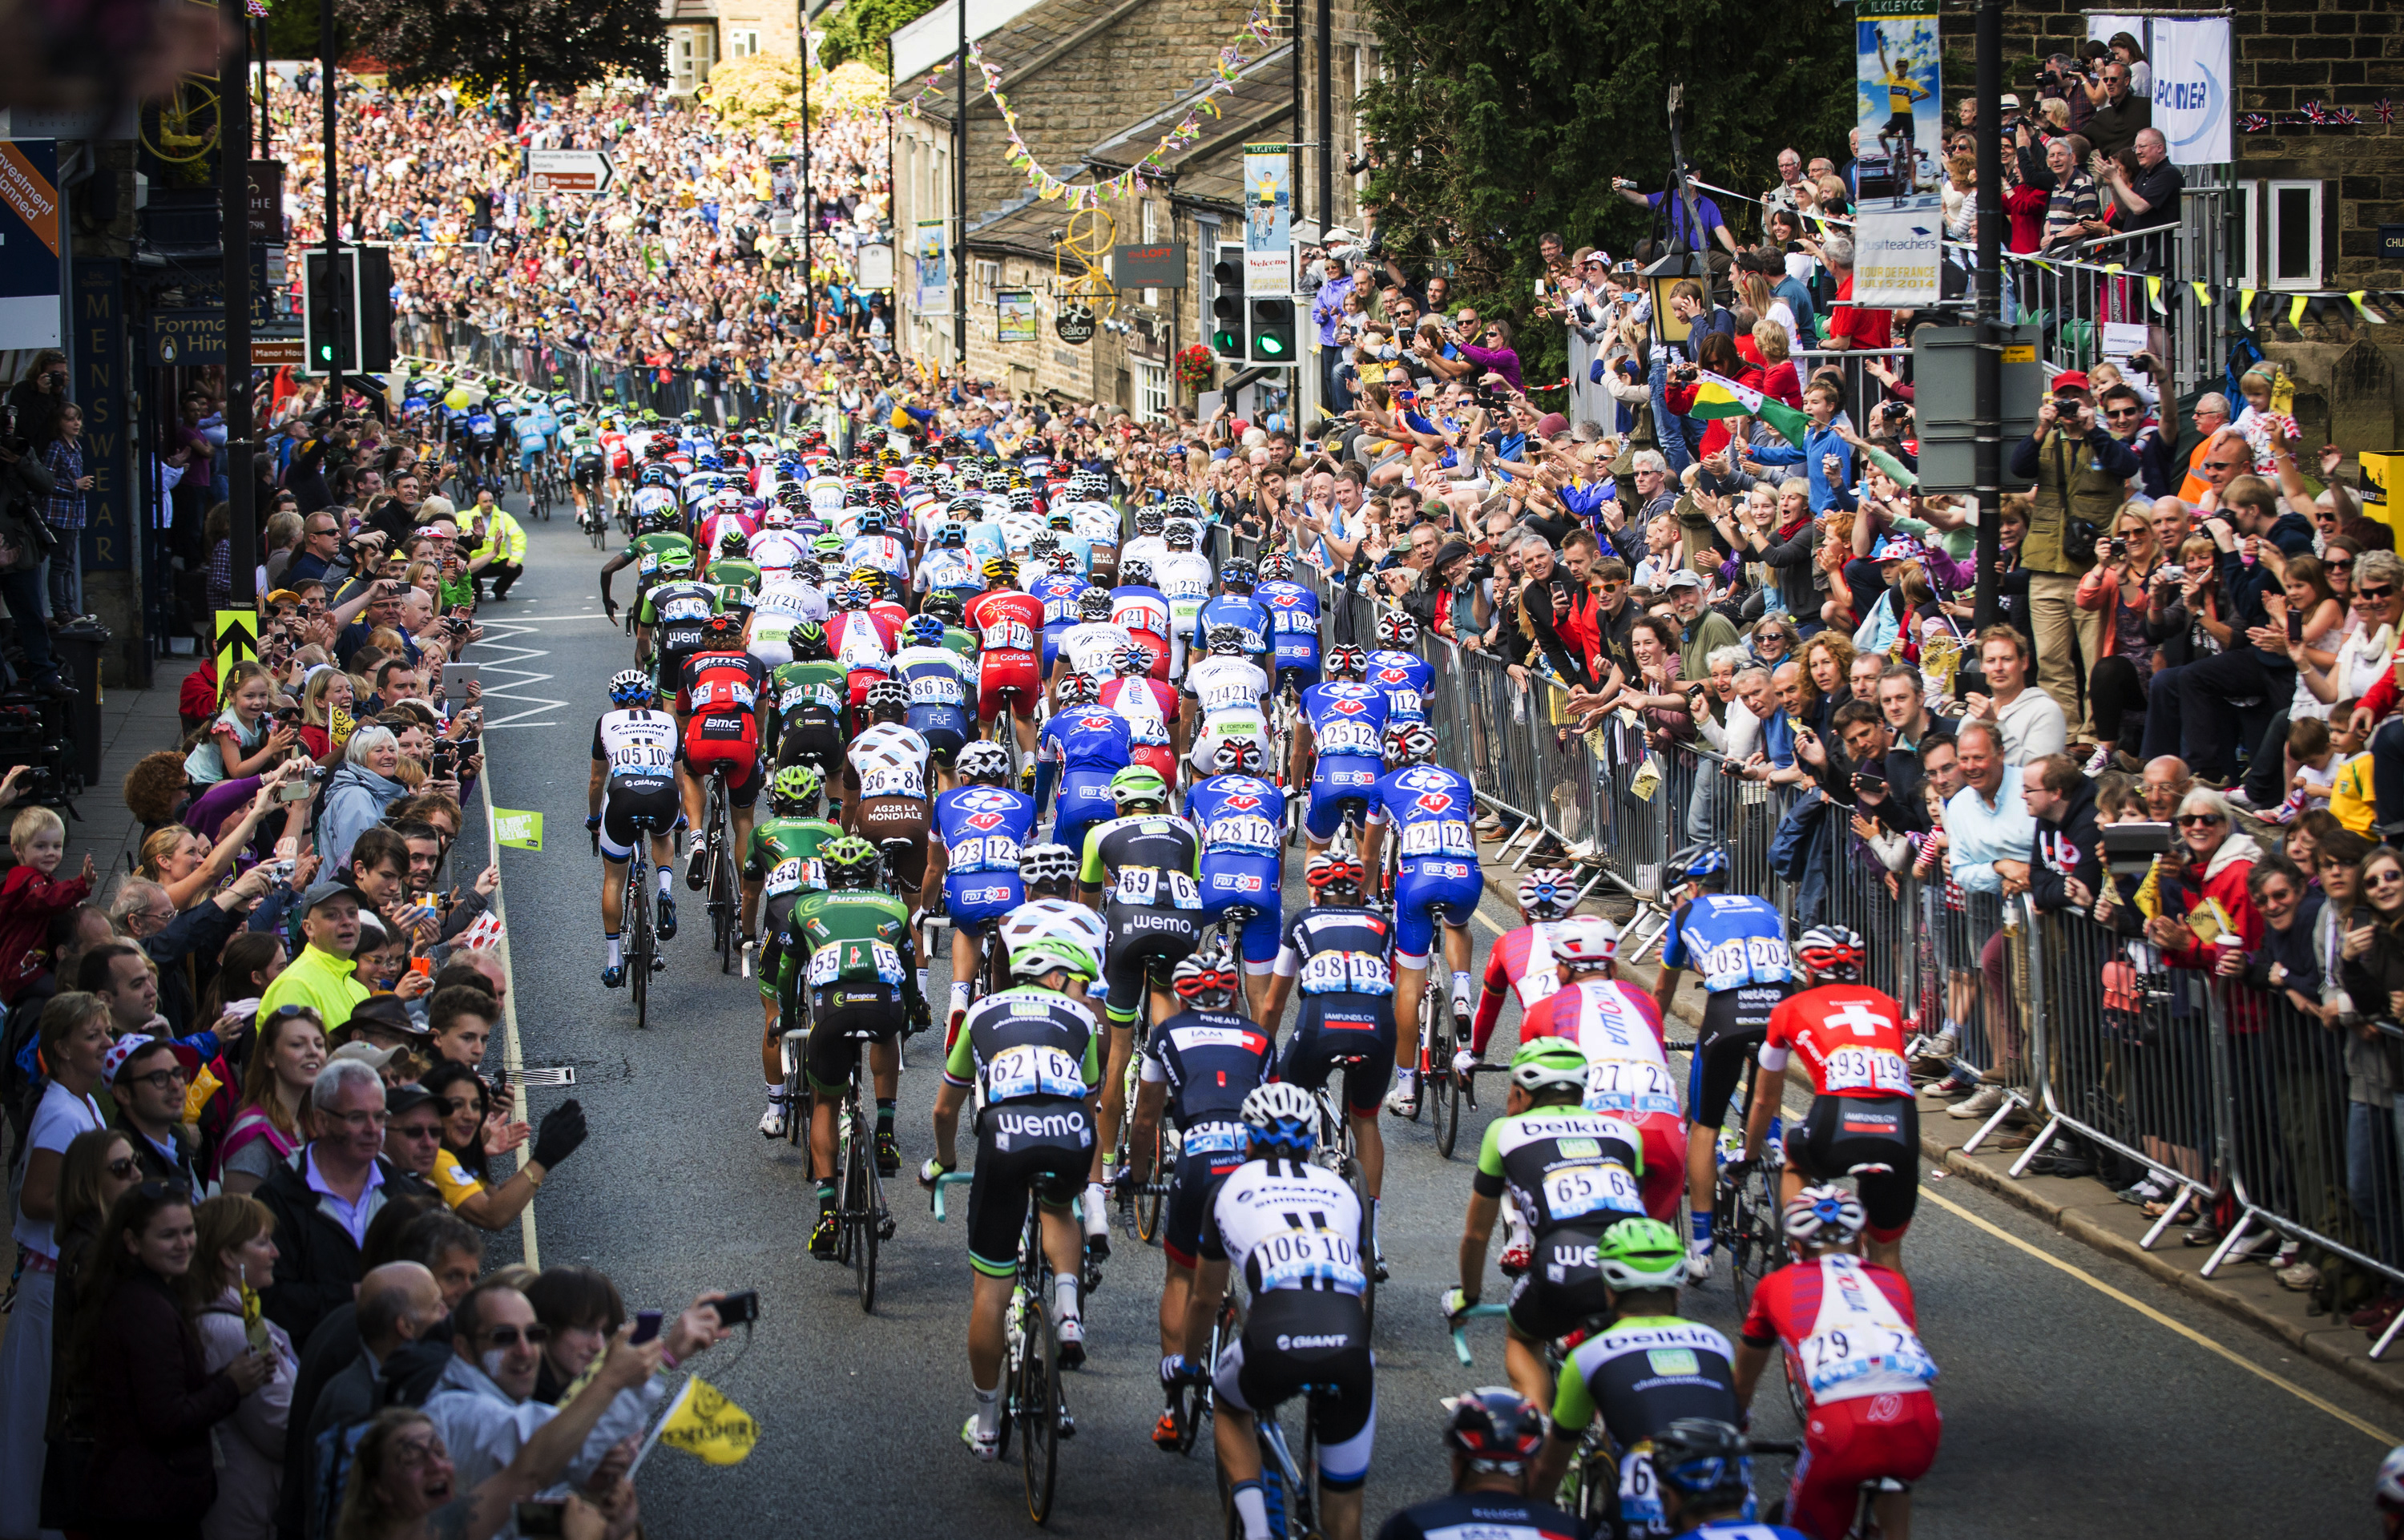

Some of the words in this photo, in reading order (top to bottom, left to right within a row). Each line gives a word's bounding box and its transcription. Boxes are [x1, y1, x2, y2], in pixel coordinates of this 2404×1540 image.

[1871, 1, 1907, 12] ILKLEY
[1910, 1, 1924, 11] CC
[0, 147, 54, 216] nvestment
[0, 174, 38, 221] lanned
[251, 198, 271, 208] HE
[2386, 237, 2404, 248] CHU
[1859, 267, 1884, 278] TOUR
[1886, 267, 1897, 277] DE
[1898, 266, 1935, 277] FRANCE
[1860, 280, 1884, 288] JULY
[1898, 280, 1935, 288] 2014
[154, 316, 225, 333] Forma
[1060, 324, 1091, 336] salon
[255, 349, 282, 357] Manor
[285, 349, 305, 357] Hou
[87, 294, 115, 562] MENSWEAR
[942, 569, 954, 583] 97
[668, 601, 683, 614] 64
[694, 600, 709, 614] 64
[993, 603, 1032, 616] Cofidis
[669, 631, 703, 644] wem
[986, 625, 1006, 644] 179
[1013, 625, 1033, 644] 179
[1000, 653, 1031, 662] Cofidis
[696, 657, 749, 673] BMC
[1385, 671, 1403, 679] .fr
[1207, 687, 1231, 708] 214
[1232, 685, 1256, 703] 214
[1402, 694, 1417, 711] 12
[1340, 701, 1359, 710] .fr
[705, 718, 741, 729] BMC
[805, 718, 827, 726] Europcar
[929, 713, 952, 725] F&F
[1087, 718, 1106, 727] .fr
[621, 724, 672, 732] GIANT
[1146, 719, 1165, 737] 28
[1321, 725, 1349, 748] 125
[1354, 726, 1379, 750] 125
[614, 747, 642, 766] 105
[634, 779, 664, 788] GIANT
[905, 771, 923, 791] 86
[1334, 774, 1350, 783] FDJ
[1081, 788, 1097, 797] FDJ
[1232, 796, 1254, 806] .fr
[1424, 794, 1445, 807] .fr
[874, 804, 905, 813] AG2R
[906, 804, 918, 812] LA
[495, 818, 506, 826] THE
[506, 814, 532, 825] WORLD'S
[778, 819, 829, 828] Europcar
[868, 812, 923, 822] MONDIALE
[974, 814, 994, 824] .fr
[498, 832, 515, 841] CYCLE
[515, 830, 532, 841] RACE
[1210, 822, 1242, 844] 128
[1406, 828, 1437, 851] 124
[951, 844, 981, 867] 123
[1426, 865, 1442, 874] FDJ
[1125, 870, 1150, 893] 69
[1177, 874, 1200, 900] 69
[1216, 877, 1233, 886] FDJ
[825, 894, 893, 907] Europcar
[964, 893, 982, 902] FDJ
[1133, 914, 1192, 934] wemo
[846, 992, 878, 1001] Europcar
[1738, 988, 1782, 1002] NetApp
[1325, 1012, 1375, 1022] IAMFUNDS.CH
[1192, 1029, 1224, 1038] IAM
[994, 1055, 1024, 1083] 62
[1049, 1053, 1079, 1081] 62
[1593, 1064, 1619, 1094] 27
[1647, 1066, 1670, 1095] 27
[997, 1111, 1084, 1137] wemo
[1521, 1117, 1620, 1137] belkin
[1211, 1155, 1247, 1165] IAMFUND
[1259, 1185, 1344, 1200] GIANT
[1557, 1173, 1592, 1203] 65
[1264, 1234, 1312, 1269] 106
[1324, 1236, 1358, 1268] 10
[1554, 1244, 1599, 1268] we
[1291, 1335, 1349, 1349] GIANT
[1605, 1329, 1721, 1350] belkin
[1814, 1331, 1851, 1366] 29
